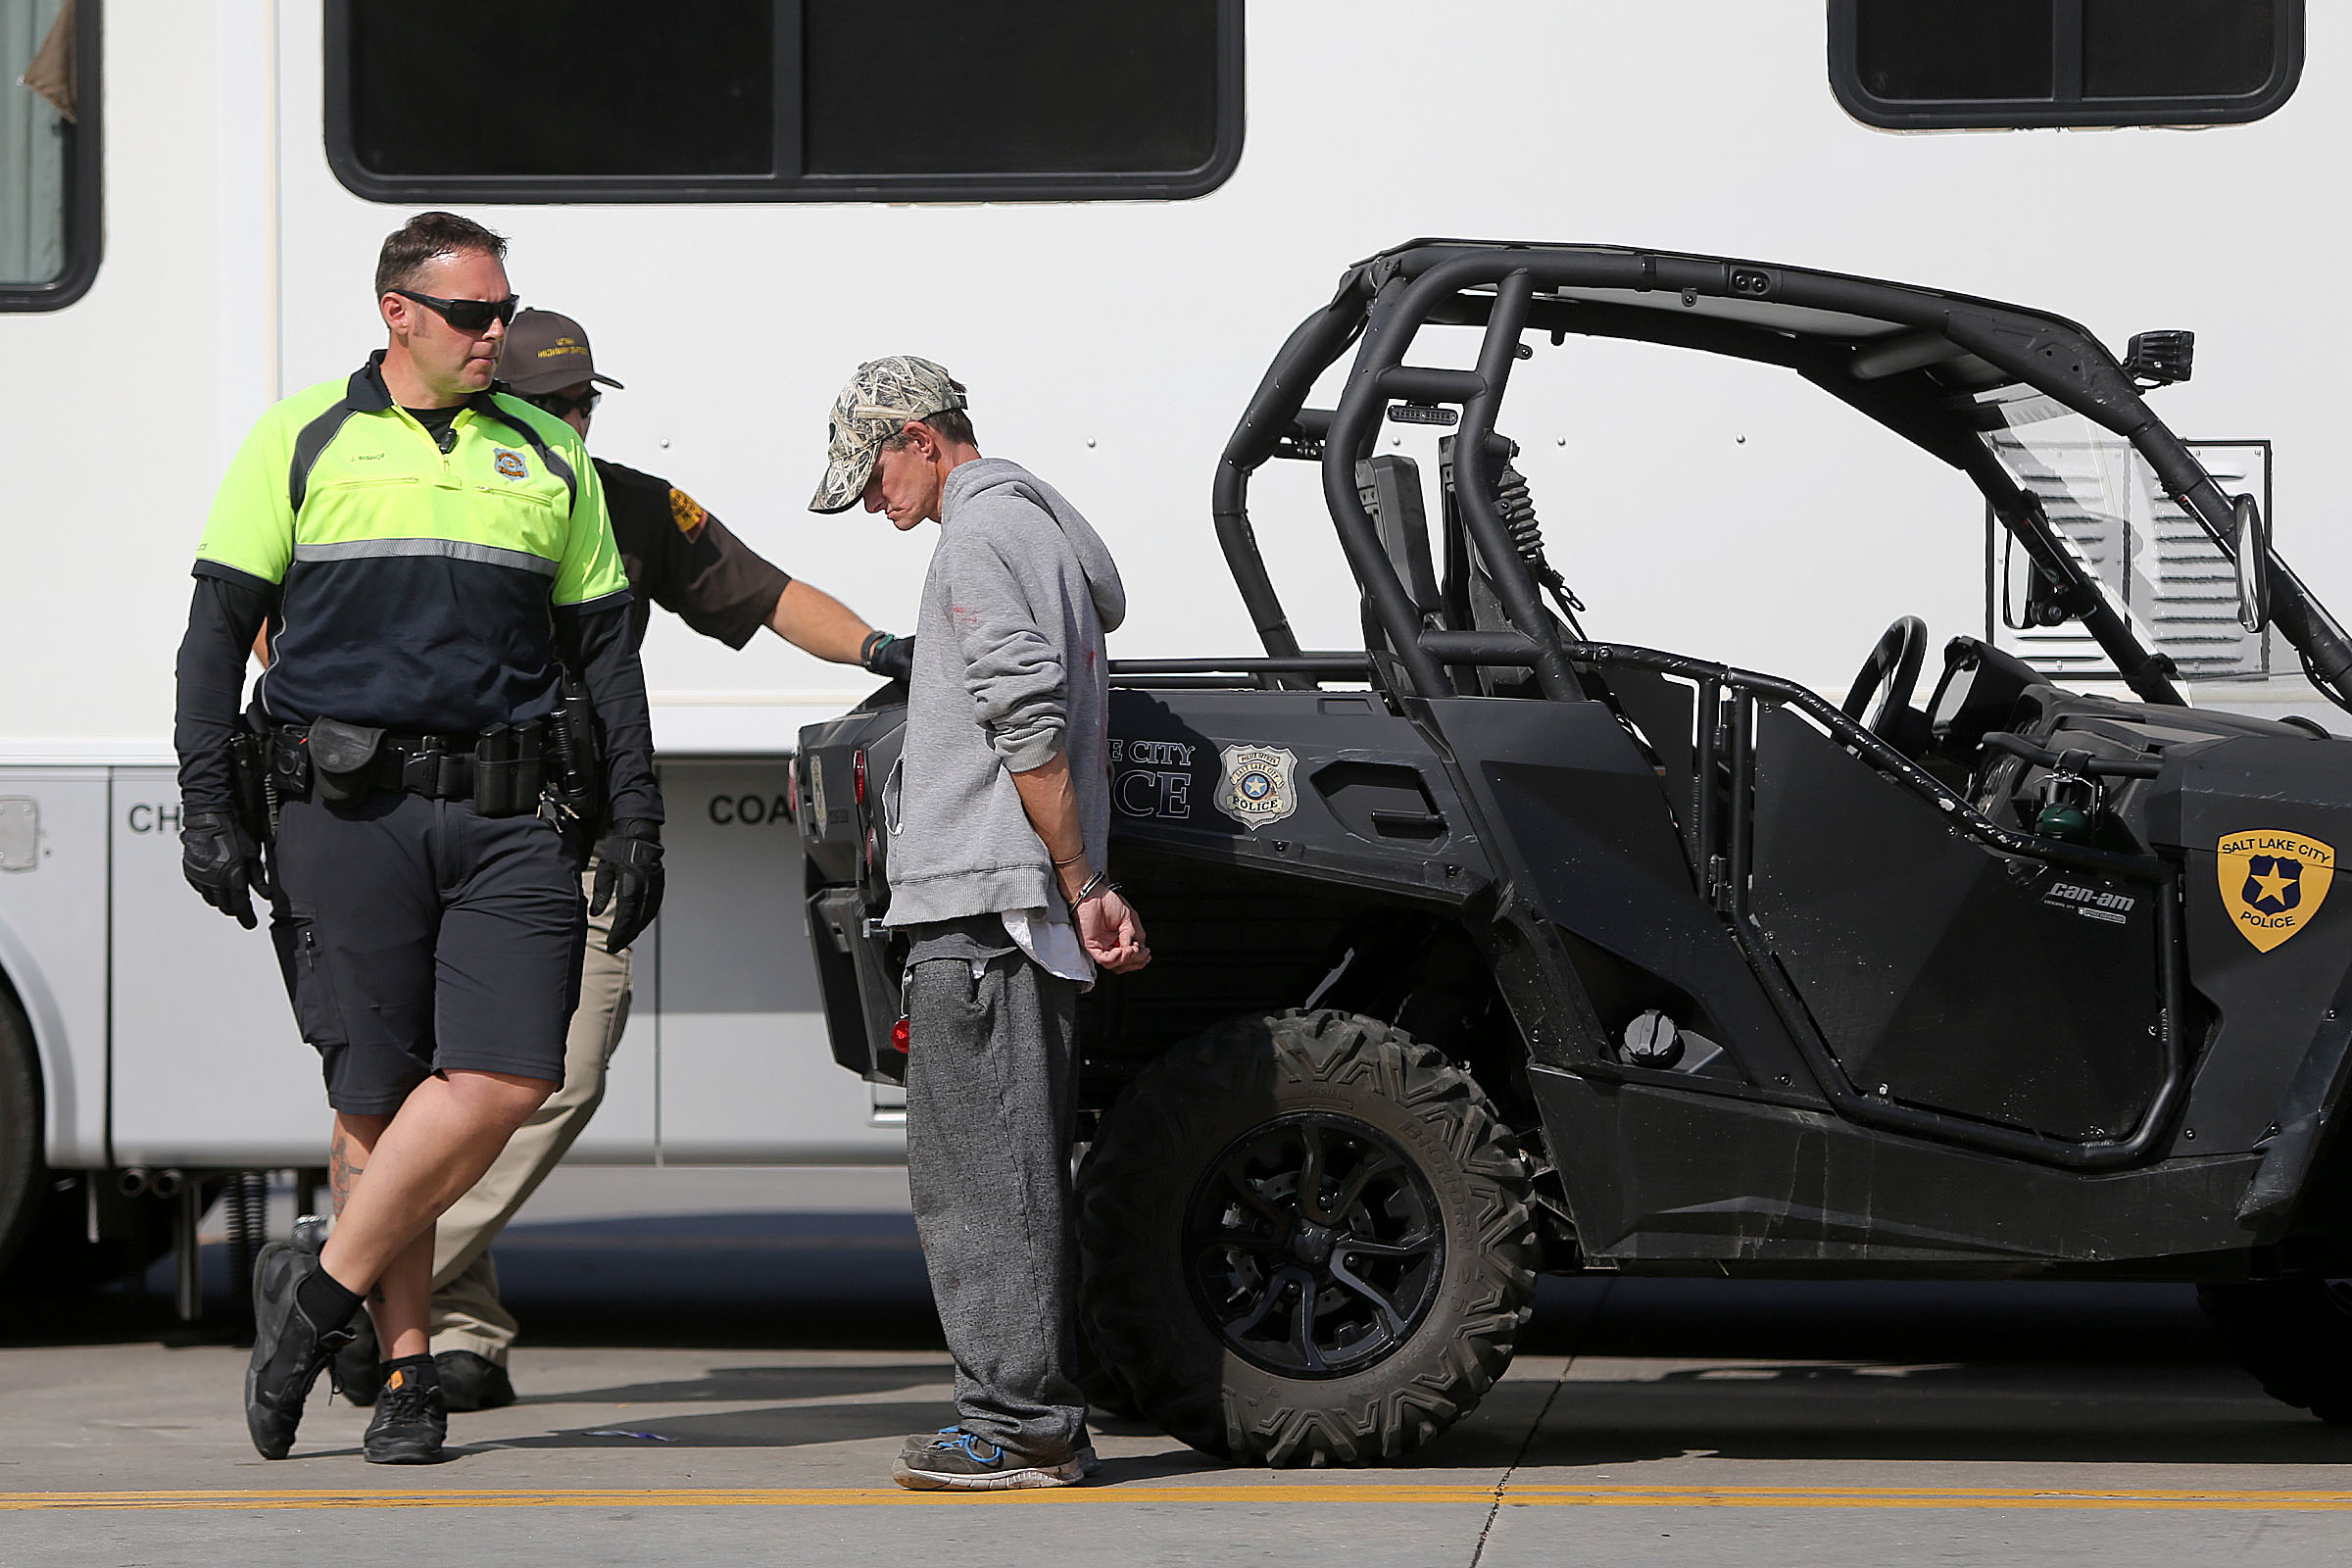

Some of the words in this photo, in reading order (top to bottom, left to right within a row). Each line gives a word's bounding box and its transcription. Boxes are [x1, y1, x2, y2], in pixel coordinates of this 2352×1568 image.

[1128, 740, 1197, 766] CITY
[1235, 764, 1250, 777] SALT
[1267, 766, 1280, 778] CITY
[1113, 769, 1192, 819] CE
[1232, 795, 1278, 811] POLICE
[129, 805, 180, 832] CH
[2222, 839, 2255, 855] SALT
[2259, 838, 2296, 852] LAKE
[2298, 844, 2331, 863] CITY
[2050, 882, 2135, 911] can-am
[2239, 910, 2296, 928] POLICE
